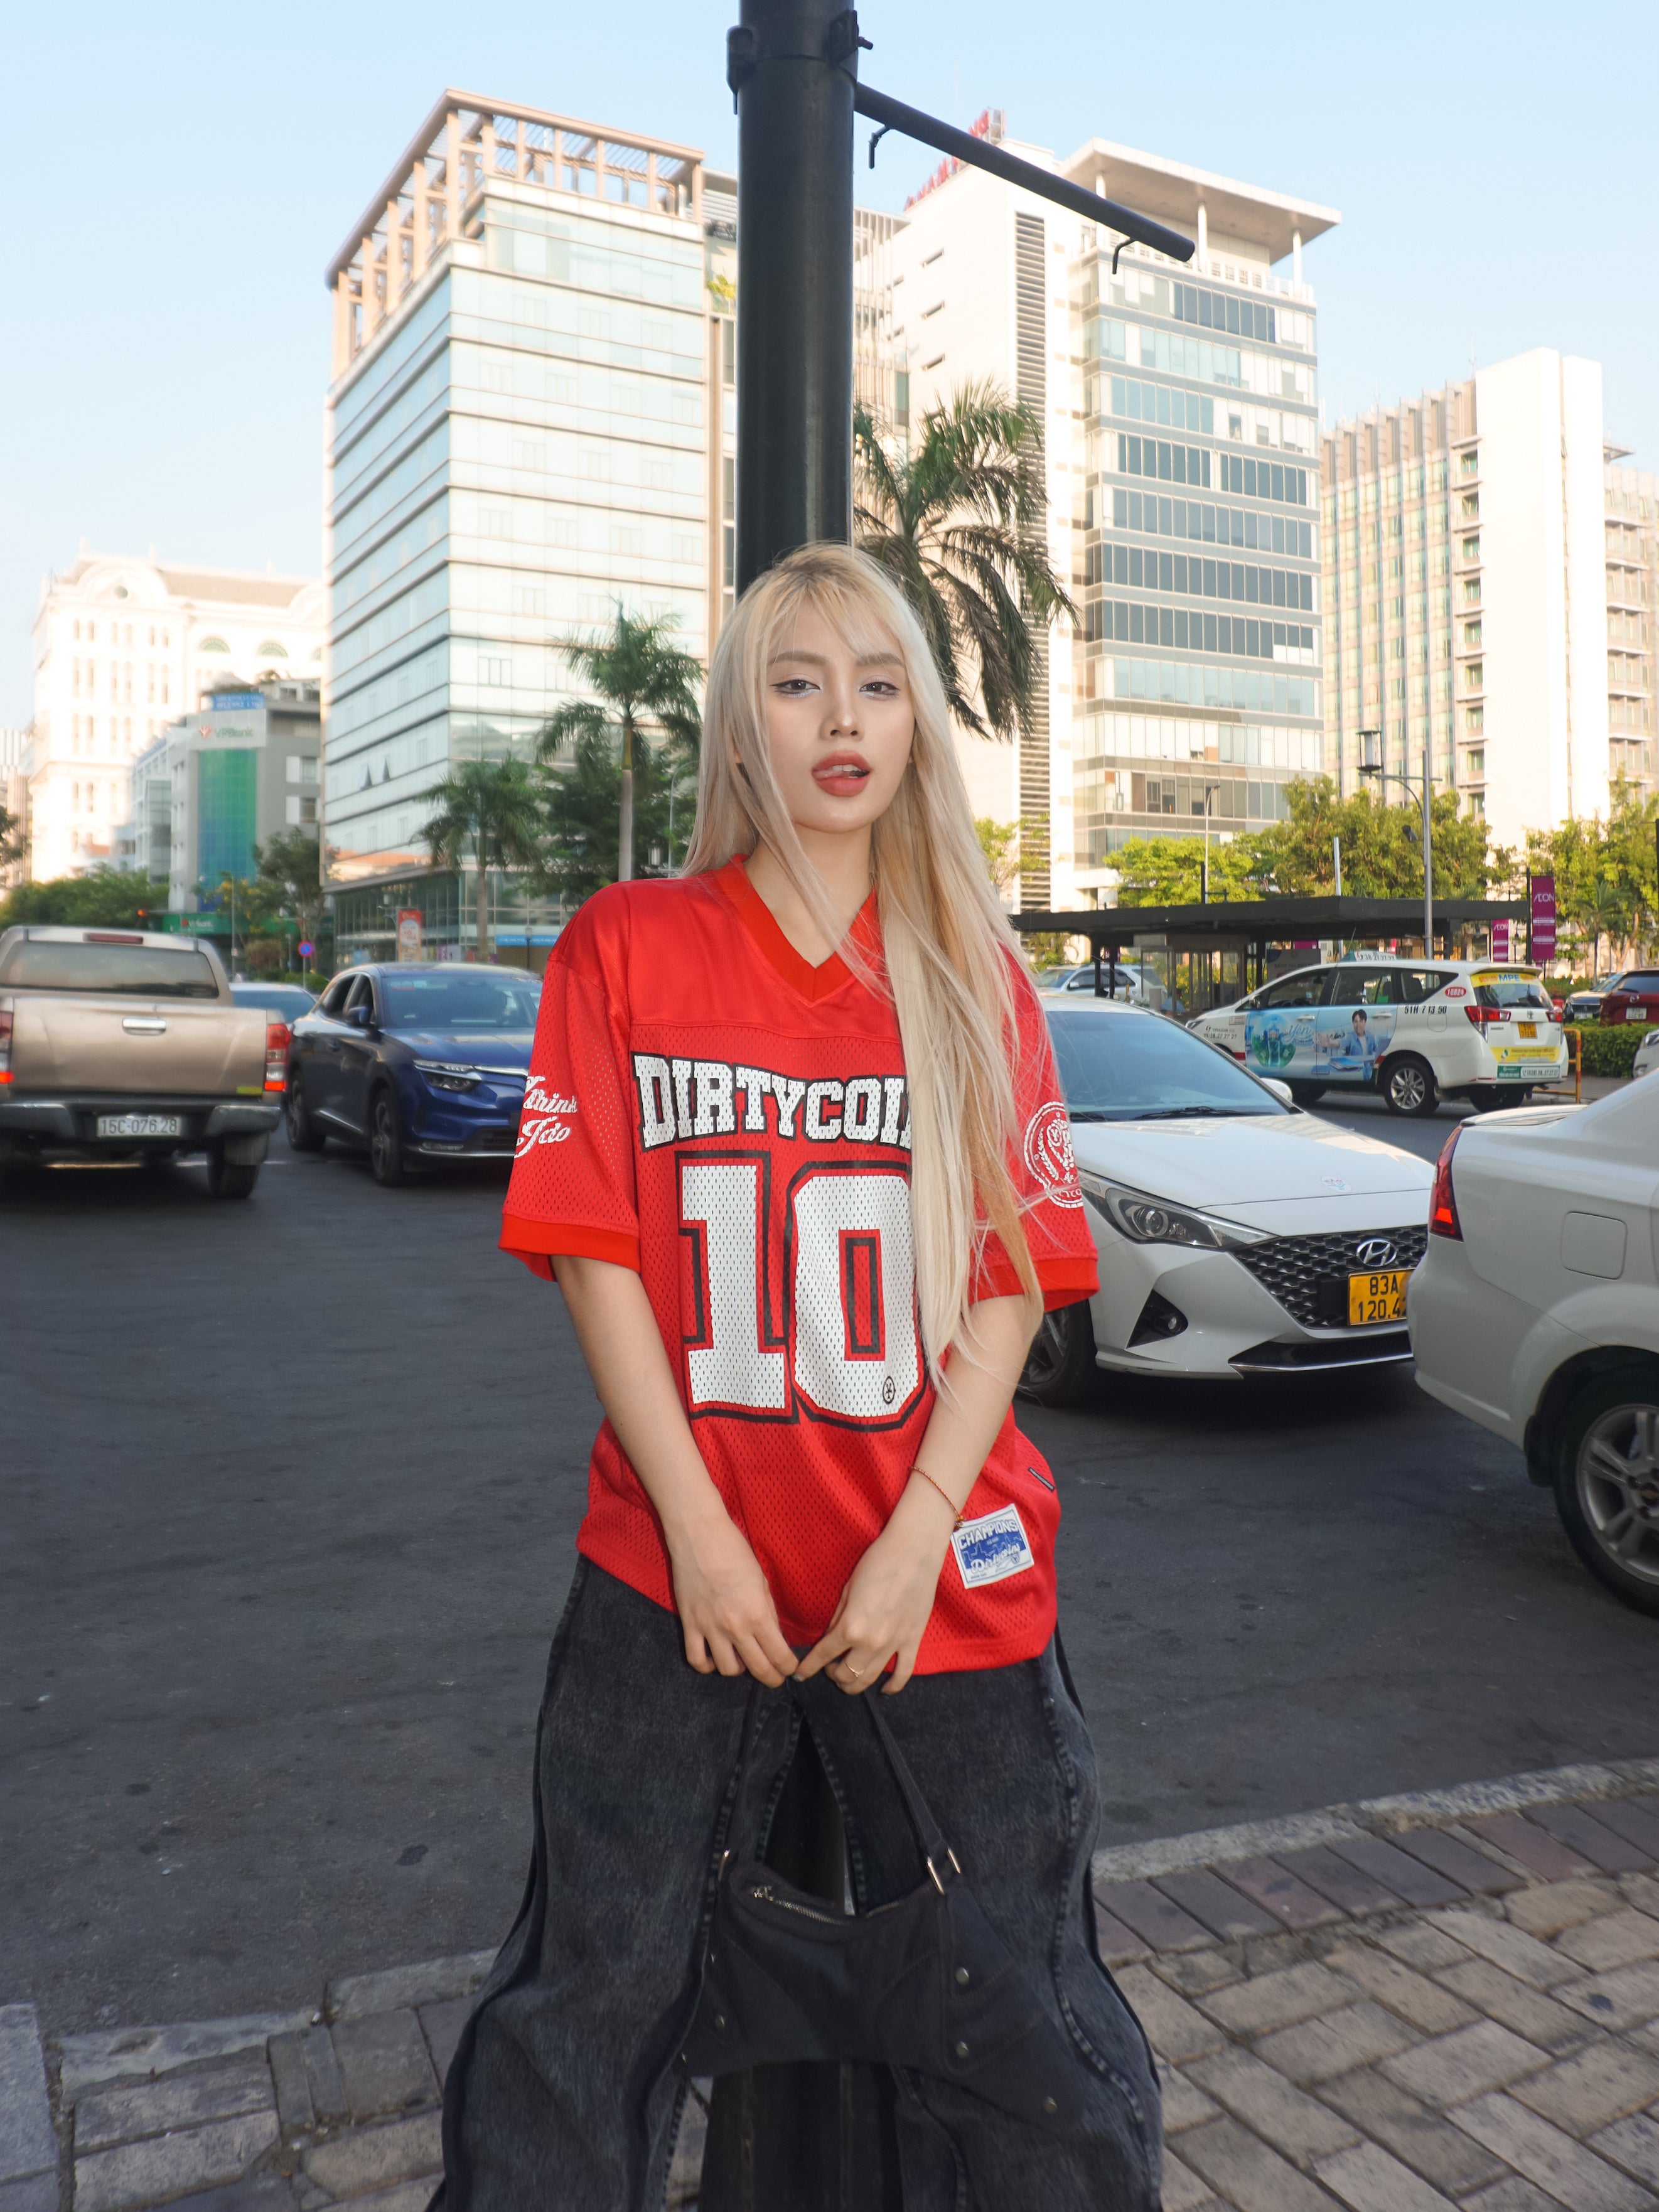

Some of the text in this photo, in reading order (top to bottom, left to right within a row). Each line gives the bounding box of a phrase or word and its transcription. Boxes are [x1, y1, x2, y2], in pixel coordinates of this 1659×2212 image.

[215, 727, 253, 738] VPBank
[101, 1119, 178, 1134] 15C-076.28
[677, 1157, 925, 1421] 10
[1369, 1274, 1400, 1296] 83A
[958, 1519, 1019, 1550] CHAMPIONS
